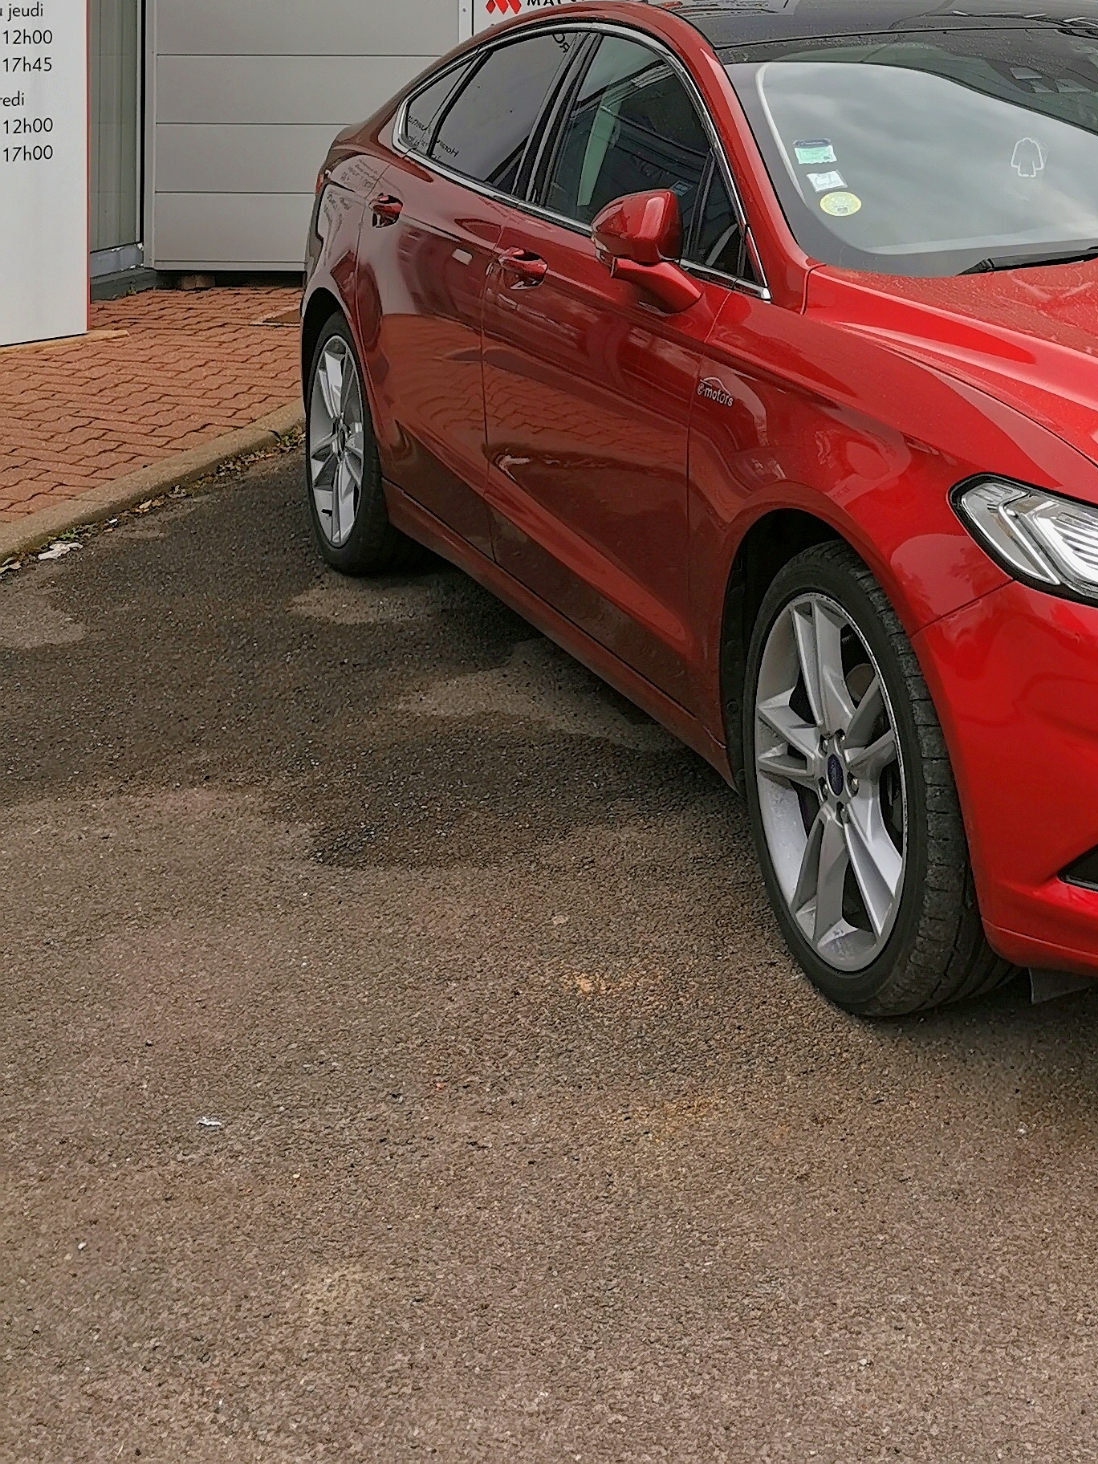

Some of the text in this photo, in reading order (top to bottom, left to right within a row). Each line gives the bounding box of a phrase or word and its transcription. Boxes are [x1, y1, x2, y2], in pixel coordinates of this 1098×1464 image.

[7, 1, 44, 22] jeudi
[2, 29, 53, 45] 12h00
[2, 56, 53, 72] 17h45
[3, 117, 54, 134] 12h00
[3, 145, 54, 162] 17h00
